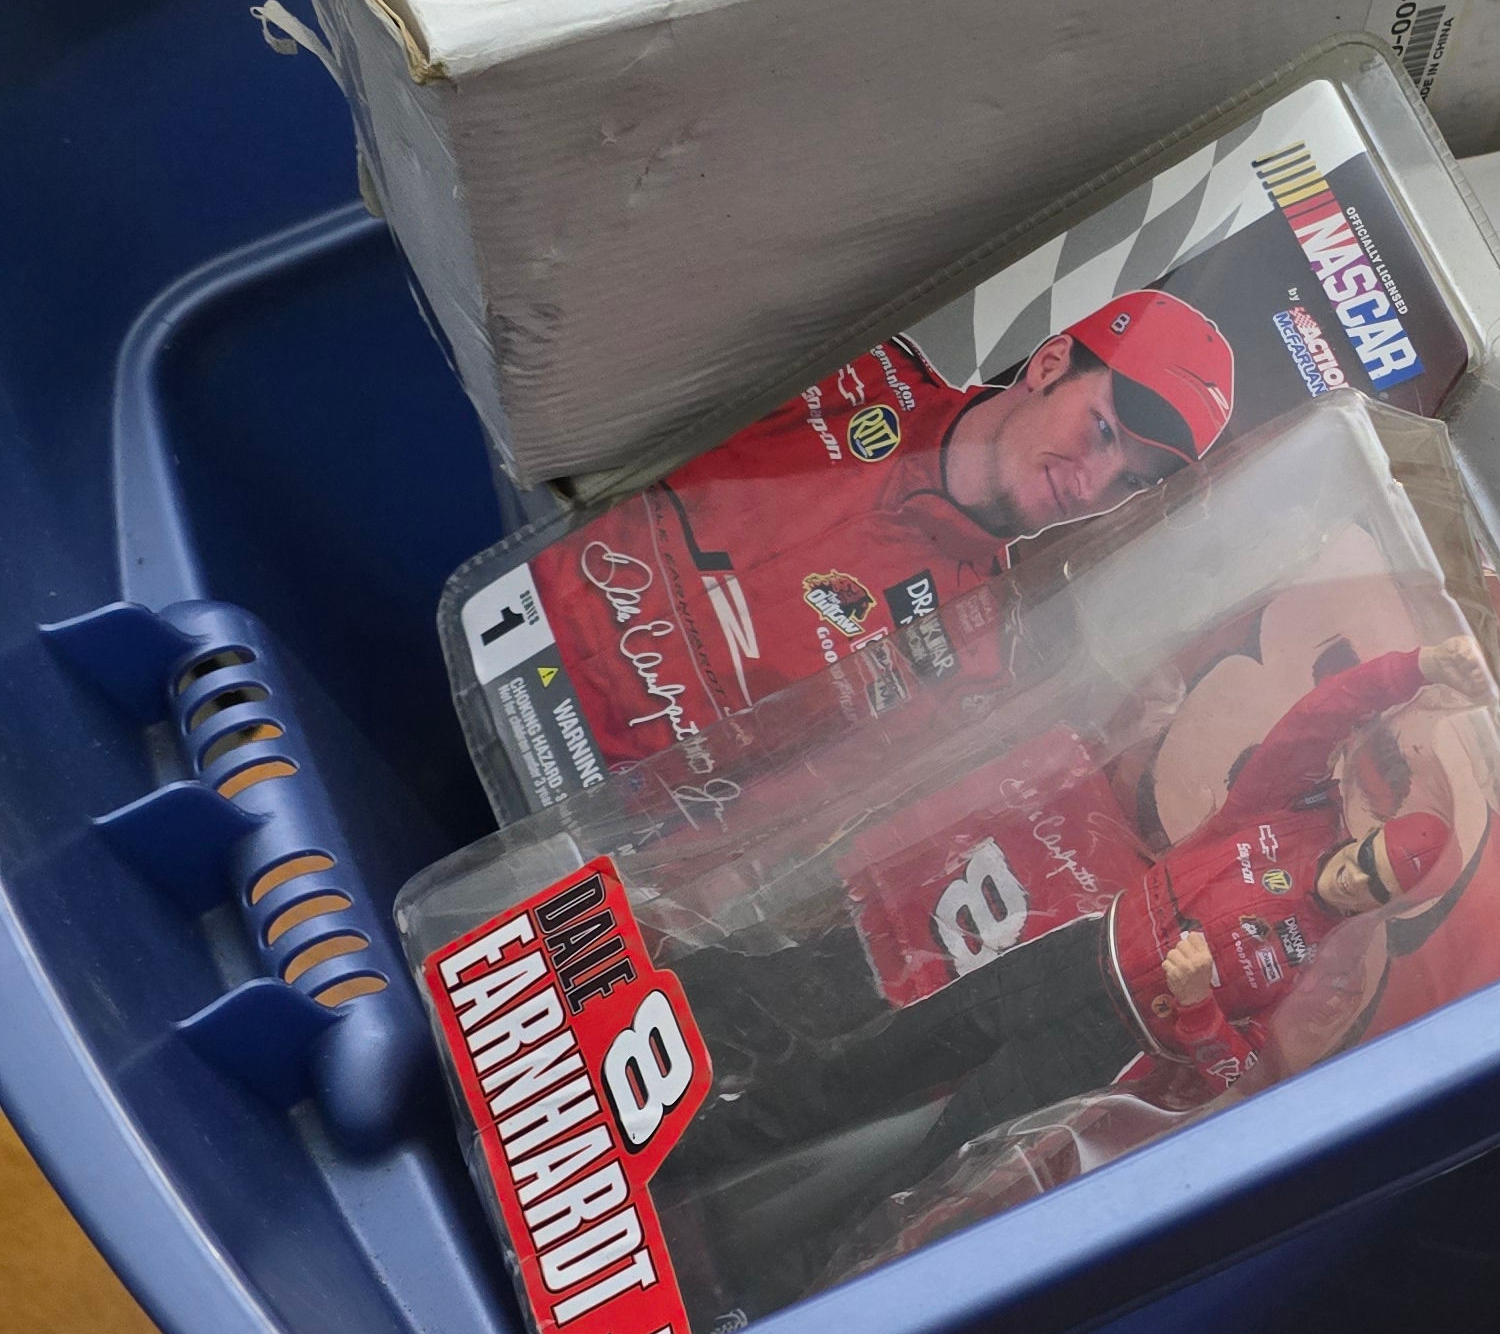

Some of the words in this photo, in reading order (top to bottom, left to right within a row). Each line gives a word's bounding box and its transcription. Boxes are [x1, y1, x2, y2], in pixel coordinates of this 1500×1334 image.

[1427, 62, 1440, 77] IN
[1433, 17, 1455, 60] CHINA
[1346, 206, 1382, 265] OFFICIALLY
[1377, 264, 1408, 315] LICENSED
[1109, 312, 1132, 336] 8
[1287, 287, 1301, 302] by
[1295, 212, 1418, 381] NASCAR
[1300, 327, 1350, 389] ACTIO
[850, 407, 900, 457] RITZ
[480, 606, 525, 646] 1
[519, 589, 540, 626] SERIES
[509, 676, 542, 736] CHOKING
[531, 733, 563, 789] HAZARD
[929, 835, 1030, 977] 8
[533, 873, 637, 1017] DALE
[602, 988, 694, 1151] 8
[436, 908, 660, 1329] EARNHARDT
